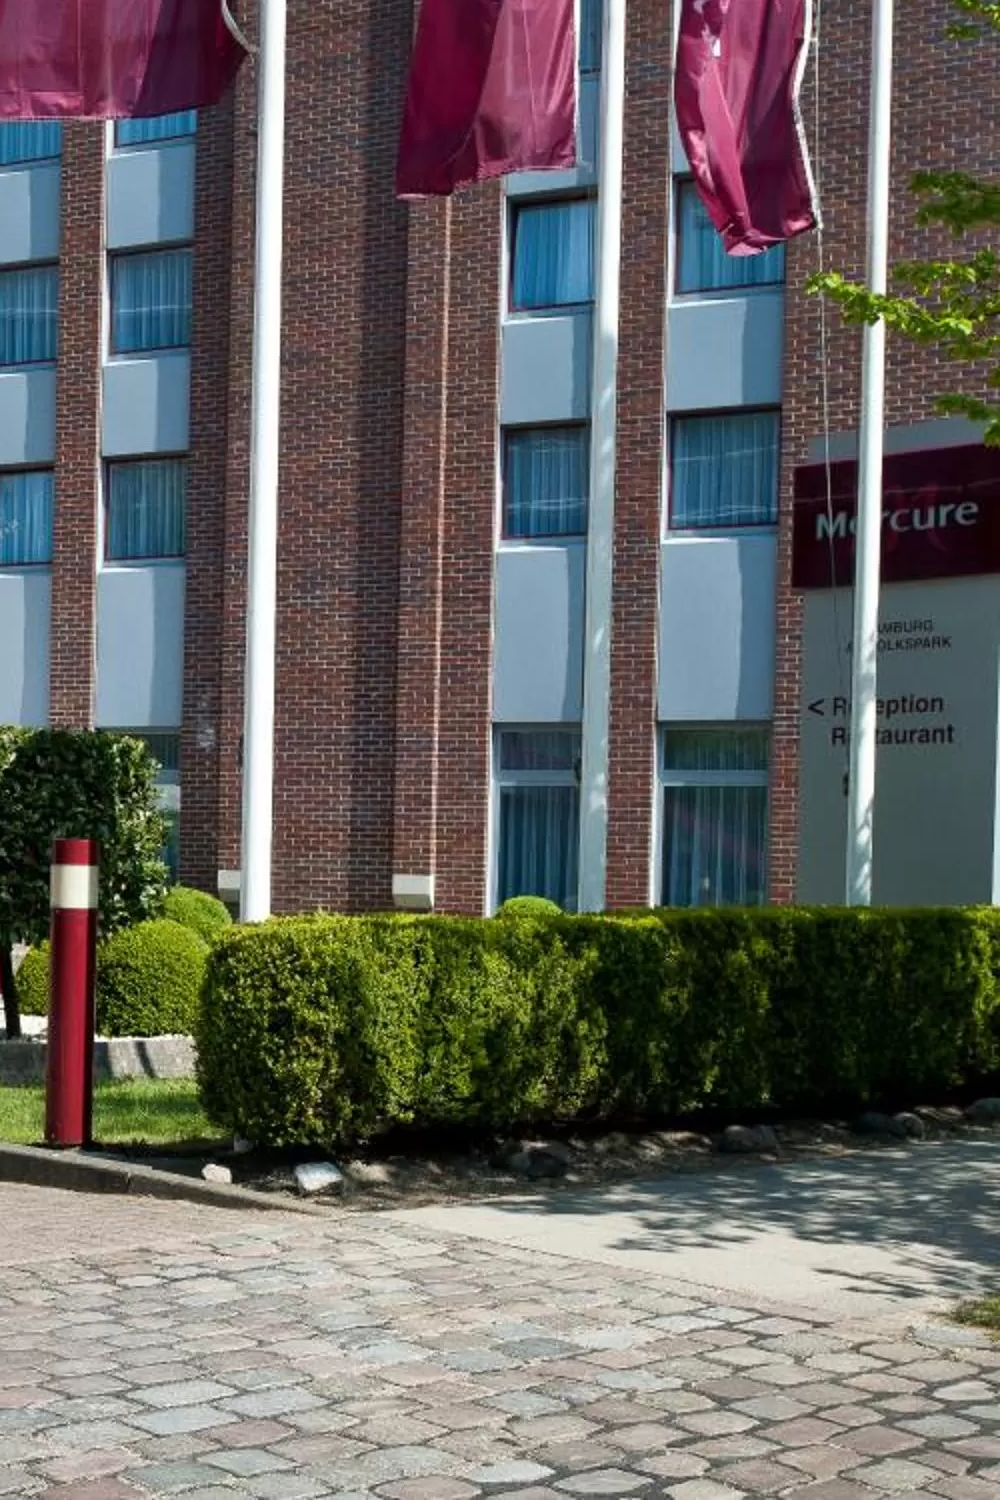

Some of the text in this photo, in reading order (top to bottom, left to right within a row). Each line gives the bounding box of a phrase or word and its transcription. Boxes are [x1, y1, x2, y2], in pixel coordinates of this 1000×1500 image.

[815, 500, 979, 541] Mcure
[877, 635, 952, 652] OLKSPARK
[832, 694, 944, 719] Reption
[831, 724, 955, 747] Rtaurant
